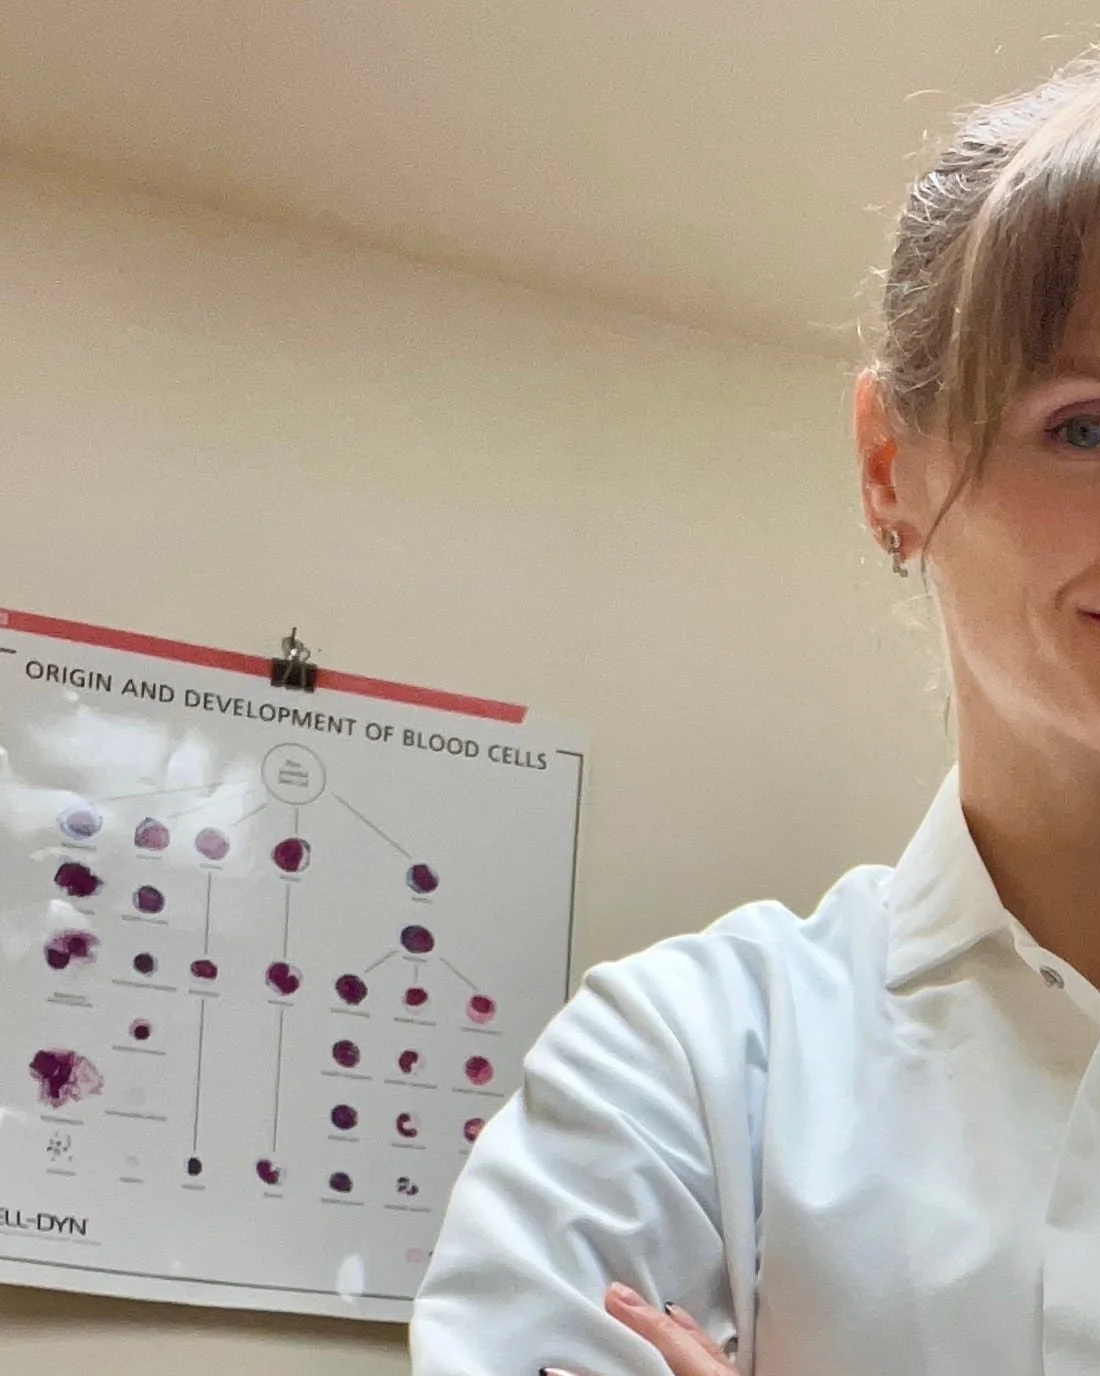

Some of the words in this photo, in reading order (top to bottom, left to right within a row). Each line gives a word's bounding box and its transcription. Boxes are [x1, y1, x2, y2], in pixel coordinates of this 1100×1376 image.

[25, 660, 112, 692] ORIGIN
[121, 678, 175, 703] AND
[184, 688, 357, 735] DEVELOPMENT
[365, 722, 395, 743] OF
[402, 729, 480, 758] BLOOD
[487, 744, 548, 770] CELLS
